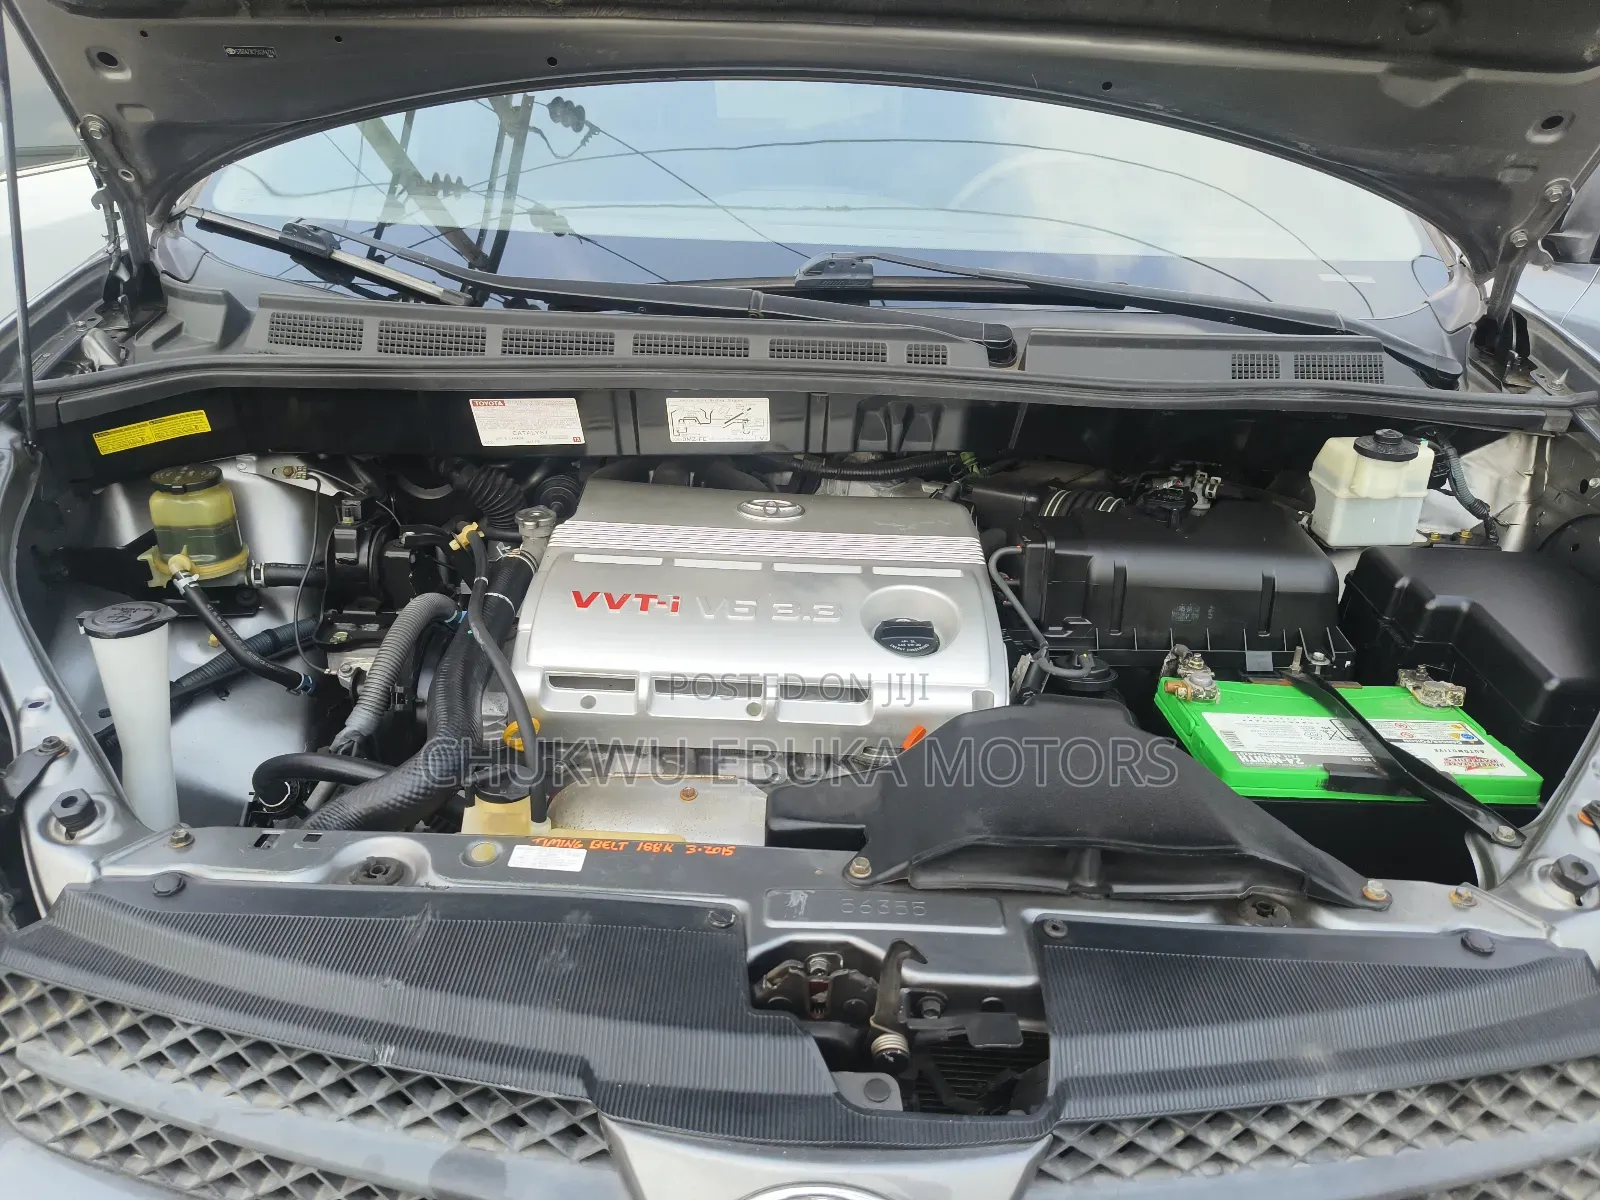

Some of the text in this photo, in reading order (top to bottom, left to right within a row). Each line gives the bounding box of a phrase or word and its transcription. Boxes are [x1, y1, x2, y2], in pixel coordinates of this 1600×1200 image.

[571, 590, 682, 615] VVT-i
[772, 601, 842, 623] 3.3
[532, 837, 584, 849] TIMING
[589, 840, 629, 851] BELT
